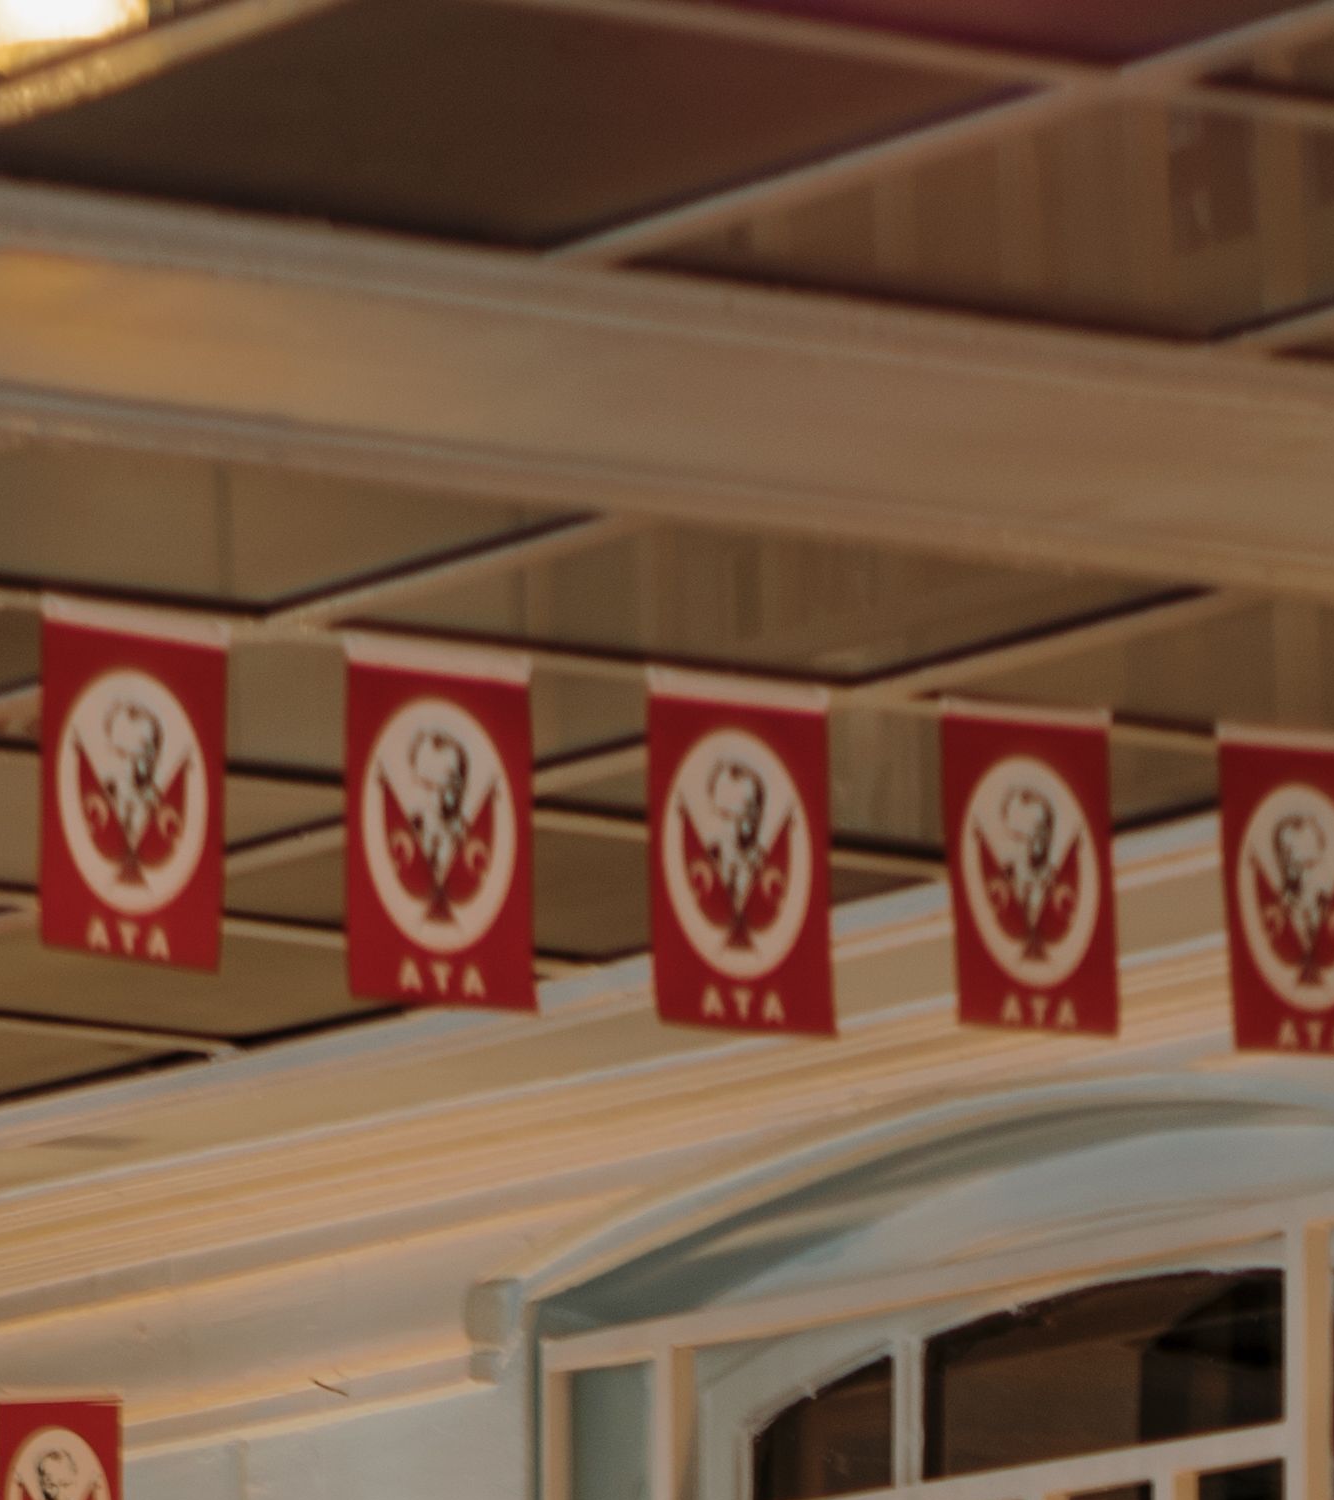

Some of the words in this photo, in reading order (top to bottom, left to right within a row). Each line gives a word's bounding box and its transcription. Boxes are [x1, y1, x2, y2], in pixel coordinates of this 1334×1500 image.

[86, 914, 170, 960] ATA
[398, 956, 486, 997] ATA
[701, 984, 785, 1024] ATA
[1000, 994, 1078, 1028] ATA
